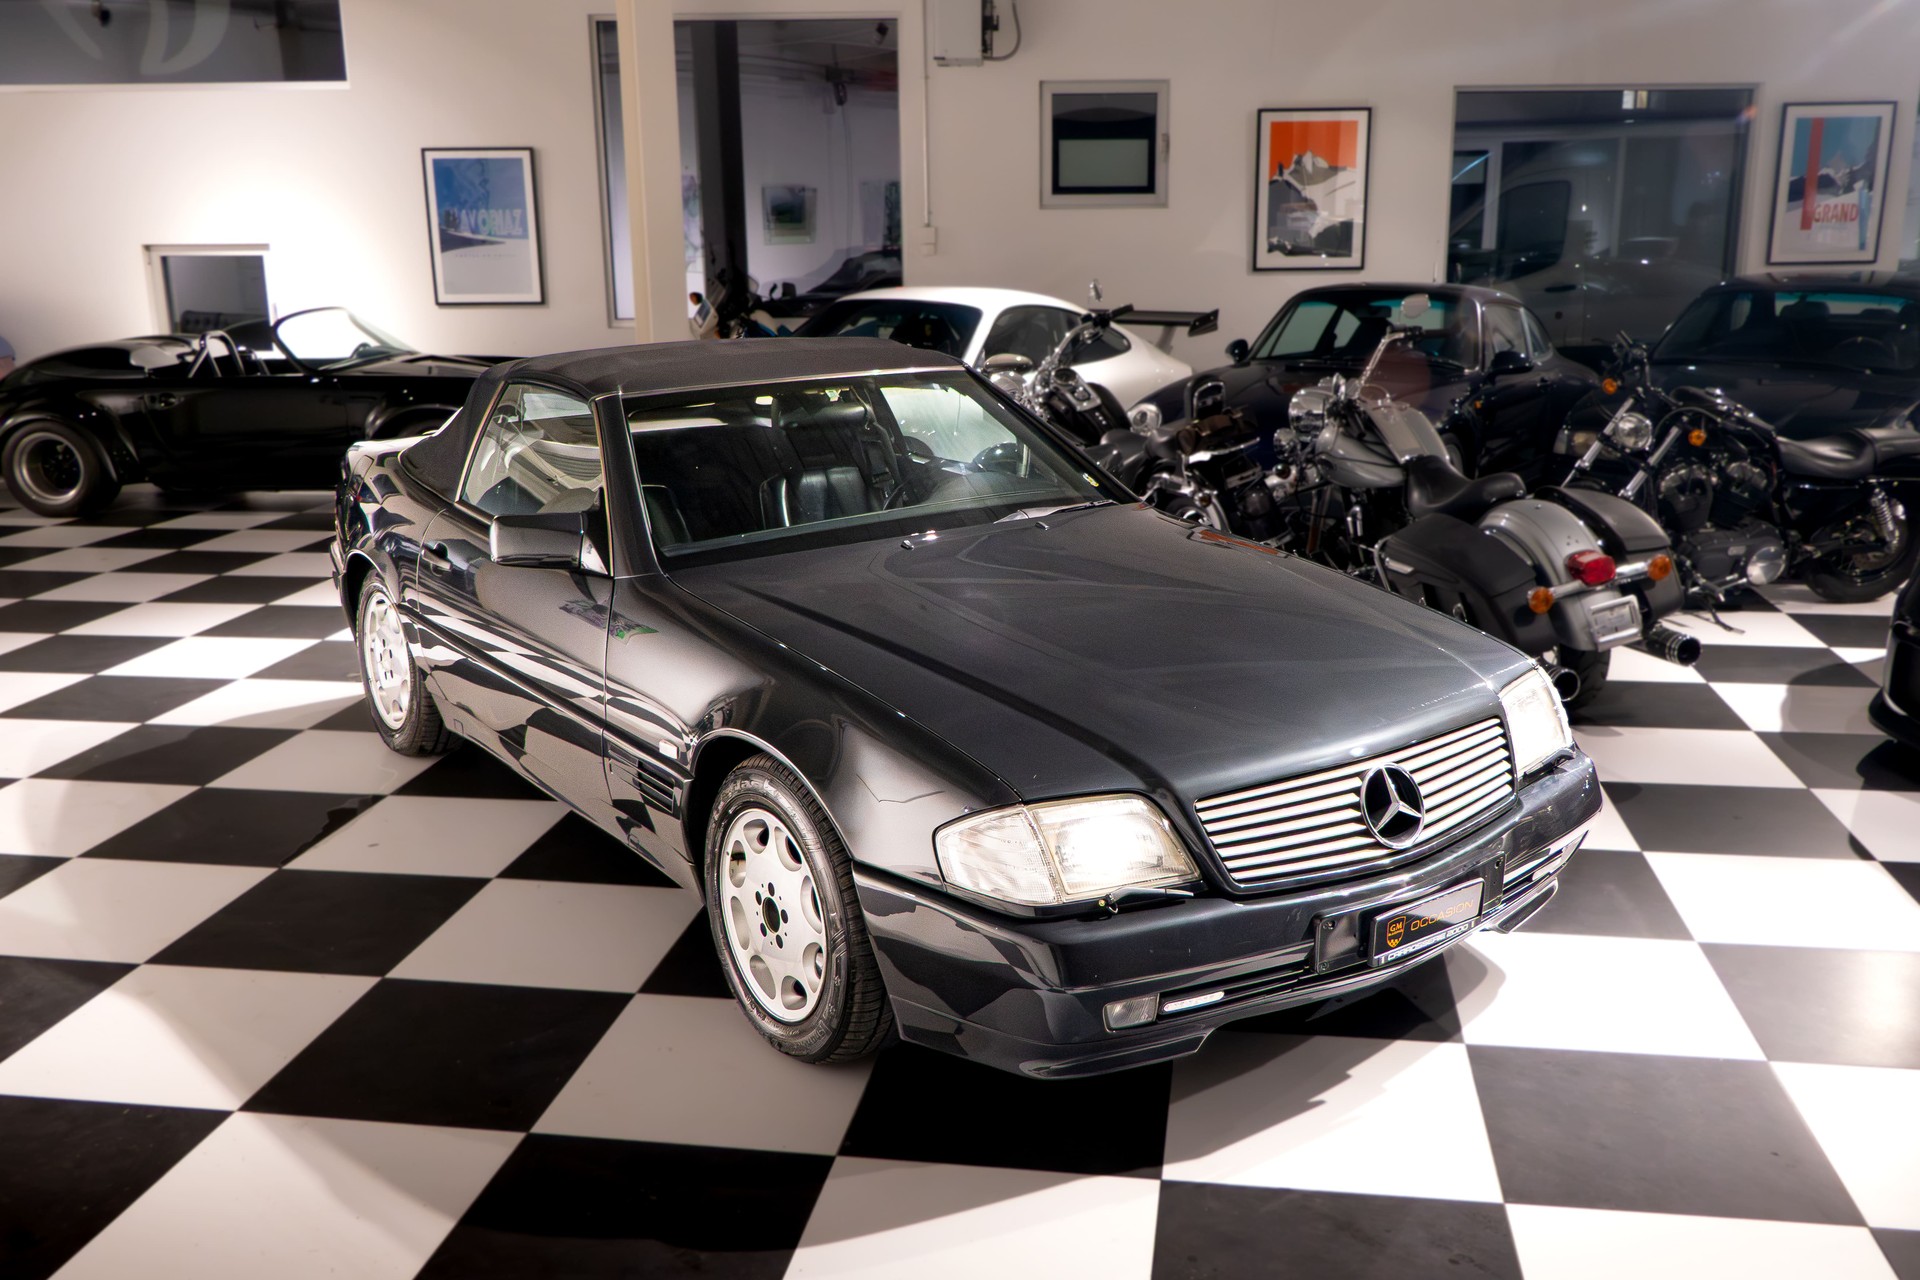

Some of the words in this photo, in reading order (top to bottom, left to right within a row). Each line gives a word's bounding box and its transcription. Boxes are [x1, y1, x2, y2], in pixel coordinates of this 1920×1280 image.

[1814, 203, 1859, 223] GRAND
[1410, 899, 1474, 931] OCCASION
[1389, 920, 1402, 932] GM
